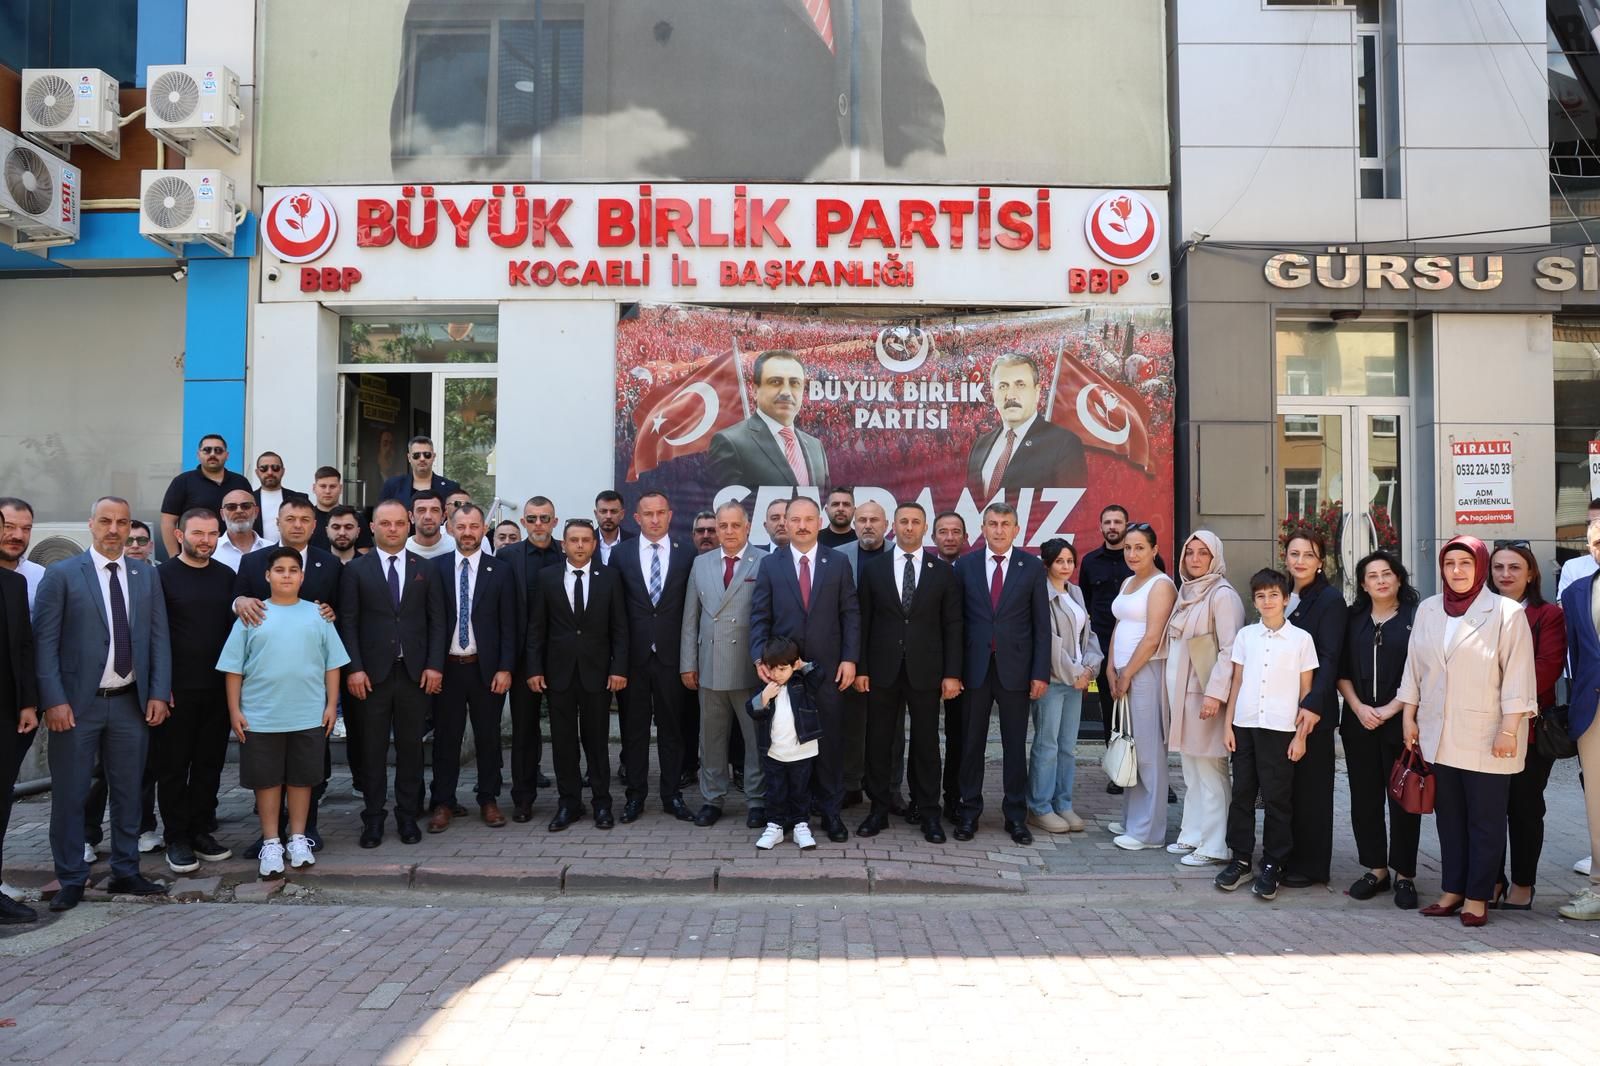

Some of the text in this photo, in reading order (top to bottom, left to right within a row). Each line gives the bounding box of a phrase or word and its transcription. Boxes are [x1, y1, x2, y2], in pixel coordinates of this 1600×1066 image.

[356, 184, 1051, 250] BÜYÜK BİRLİK PARTİSİ
[300, 267, 362, 292] BBP
[508, 252, 914, 290] KOCAELİ İL BAŞKANLIĞI
[1068, 268, 1129, 294] BBP
[1264, 246, 1503, 291] GÜRSU
[809, 375, 986, 402] BÜYÜK BİRLİK
[854, 403, 948, 430] PARTİSİ
[1456, 462, 1510, 476] 0532 224 50 33
[1458, 496, 1511, 506] GAYRİMENKUL
[1475, 489, 1493, 497] ADM
